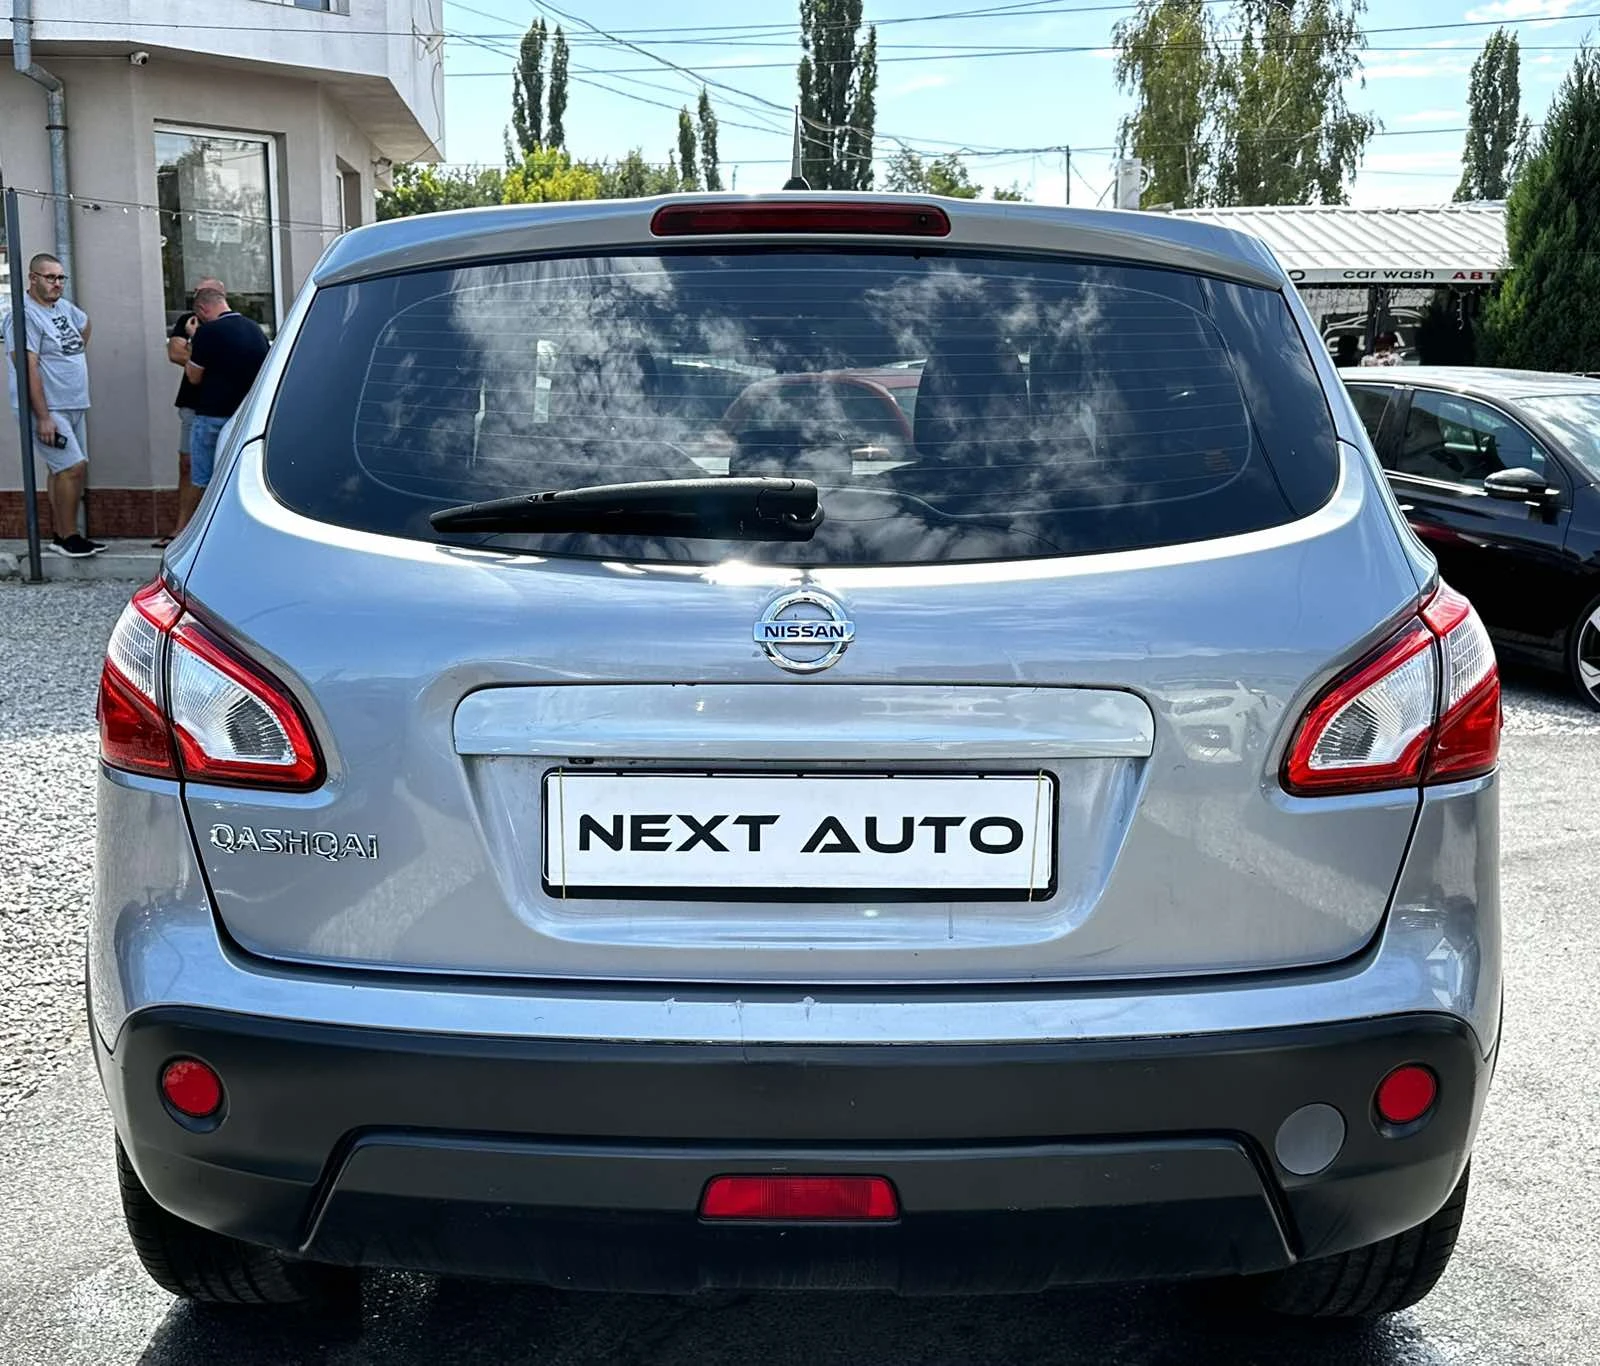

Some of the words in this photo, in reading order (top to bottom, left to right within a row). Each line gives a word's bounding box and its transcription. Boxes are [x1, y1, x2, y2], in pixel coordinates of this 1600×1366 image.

[1343, 270, 1377, 279] car
[1383, 269, 1435, 280] wash
[764, 625, 844, 638] NISSAN
[209, 823, 379, 862] QASHQAI
[579, 814, 781, 852] NEXT
[799, 815, 1024, 854] AUTO
